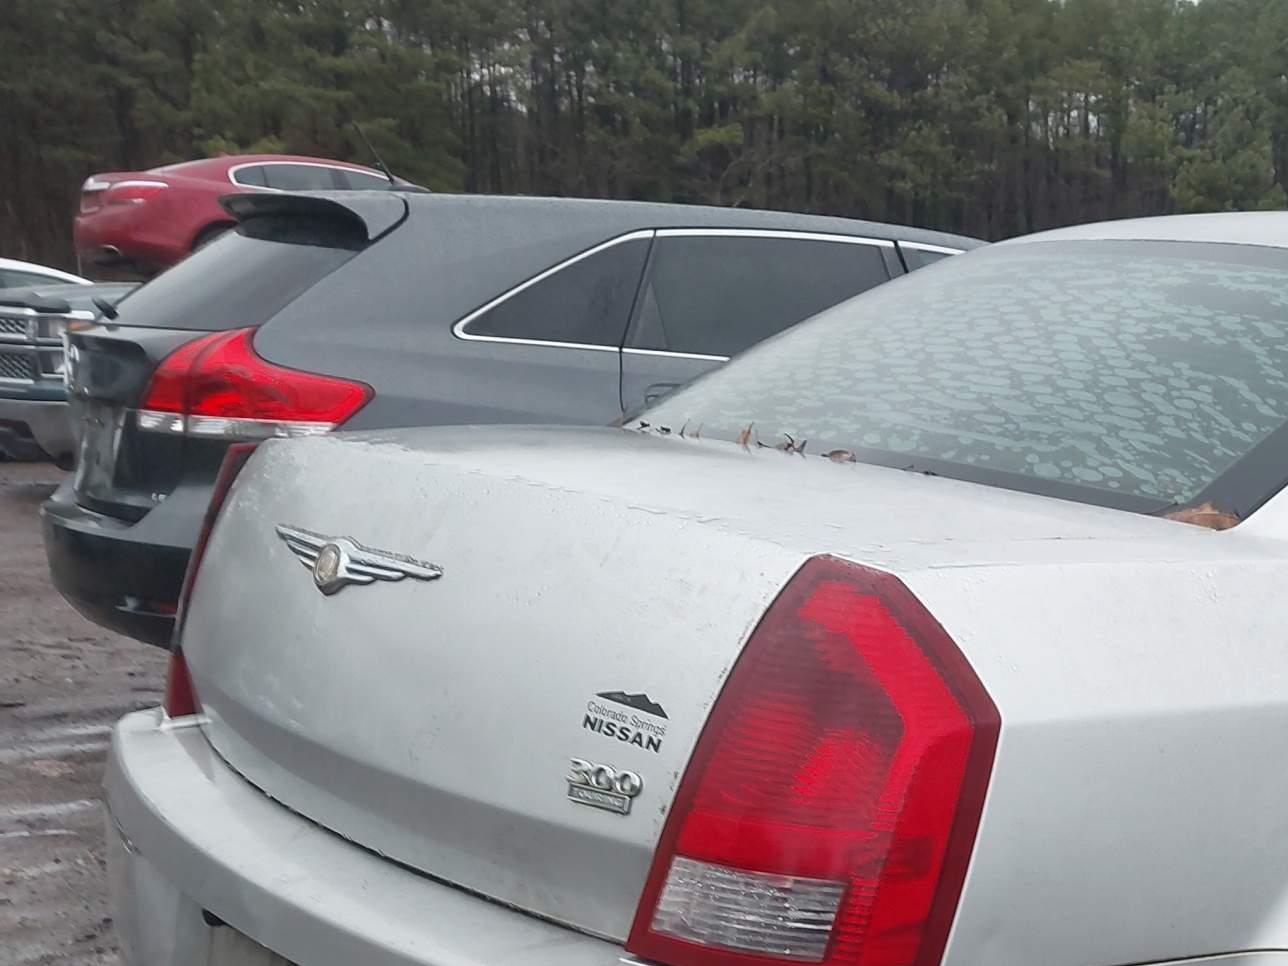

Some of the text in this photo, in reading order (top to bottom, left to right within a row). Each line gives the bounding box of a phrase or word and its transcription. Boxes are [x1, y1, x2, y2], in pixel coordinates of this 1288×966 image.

[583, 713, 662, 753] NISSAN
[587, 700, 667, 737] Colorado Springs
[566, 757, 643, 797] 300
